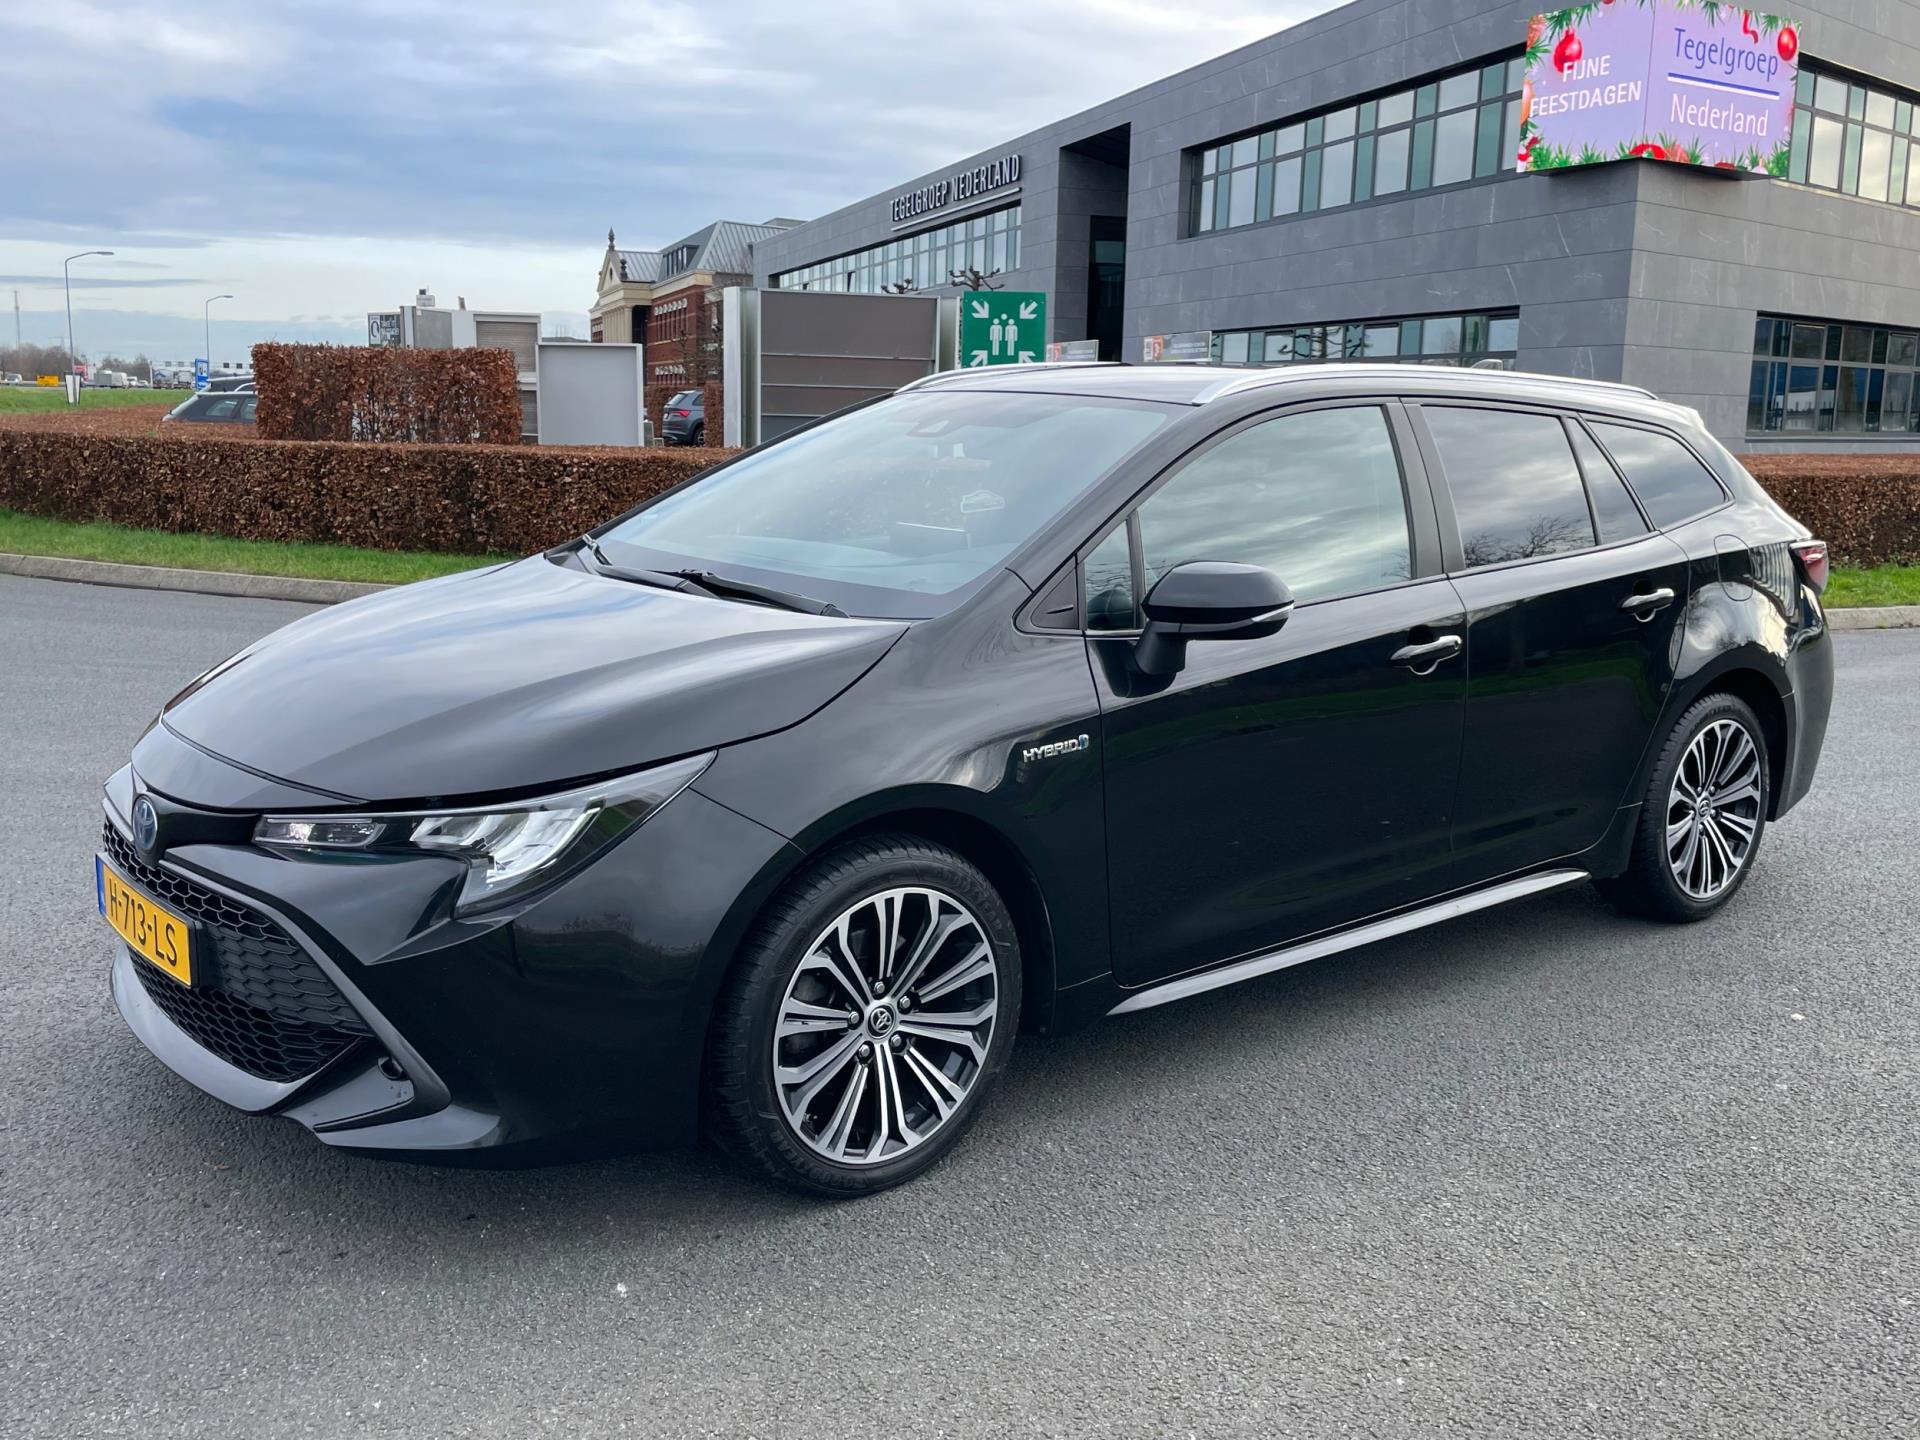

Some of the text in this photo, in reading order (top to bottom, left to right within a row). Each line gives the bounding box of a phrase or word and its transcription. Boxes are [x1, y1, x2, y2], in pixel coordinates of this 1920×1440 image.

[1562, 55, 1611, 83] FIJNE
[1674, 27, 1778, 82] Tegelgroep
[1529, 80, 1642, 117] FEESTDAGEN
[1671, 93, 1769, 136] Nederland
[889, 154, 1021, 221] TEGELGROEP NEDERLAND
[1022, 739, 1079, 763] HYBRID
[109, 878, 178, 967] H-713-LS
